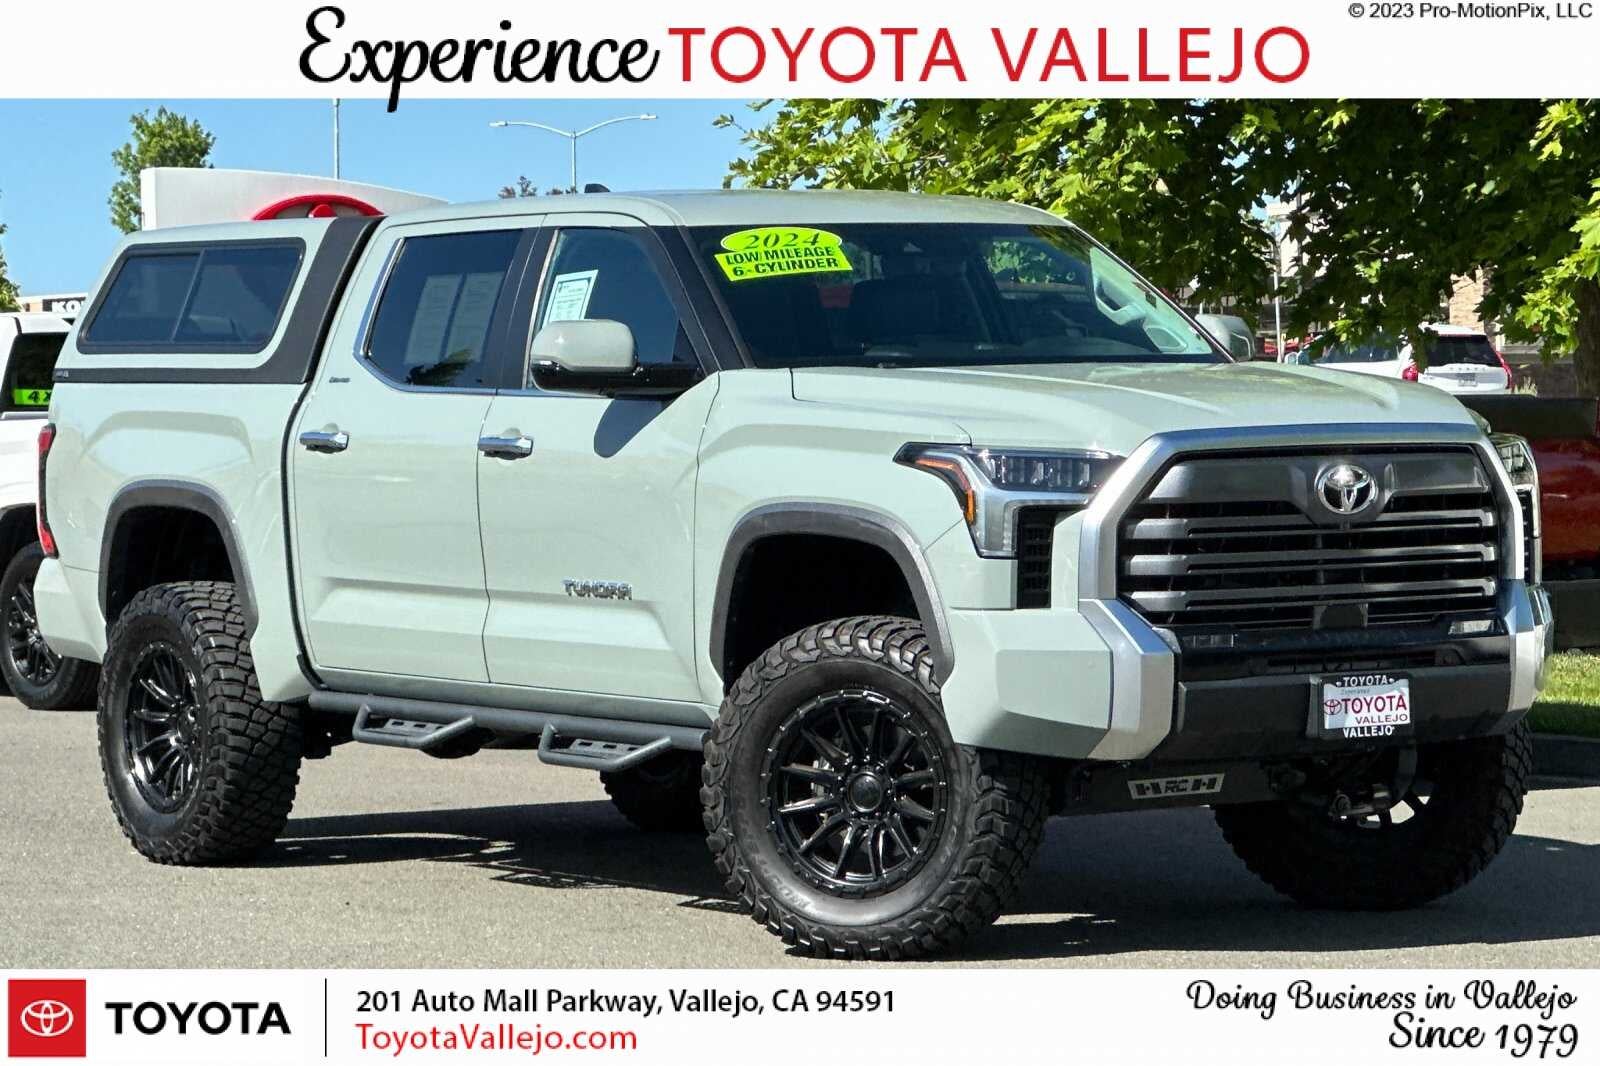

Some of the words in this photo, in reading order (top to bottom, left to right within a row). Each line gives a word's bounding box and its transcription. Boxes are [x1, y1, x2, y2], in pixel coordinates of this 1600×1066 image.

[744, 232, 820, 250] 2024
[725, 251, 759, 265] LOW
[764, 246, 833, 262] MILEAGE
[51, 299, 84, 312] KO
[563, 578, 632, 601] TUNDRA
[1343, 674, 1389, 688] TOYOTA
[1340, 694, 1408, 714] TOYOTA
[1355, 713, 1409, 725] VALLEJO
[1343, 725, 1394, 739] VALLEJO
